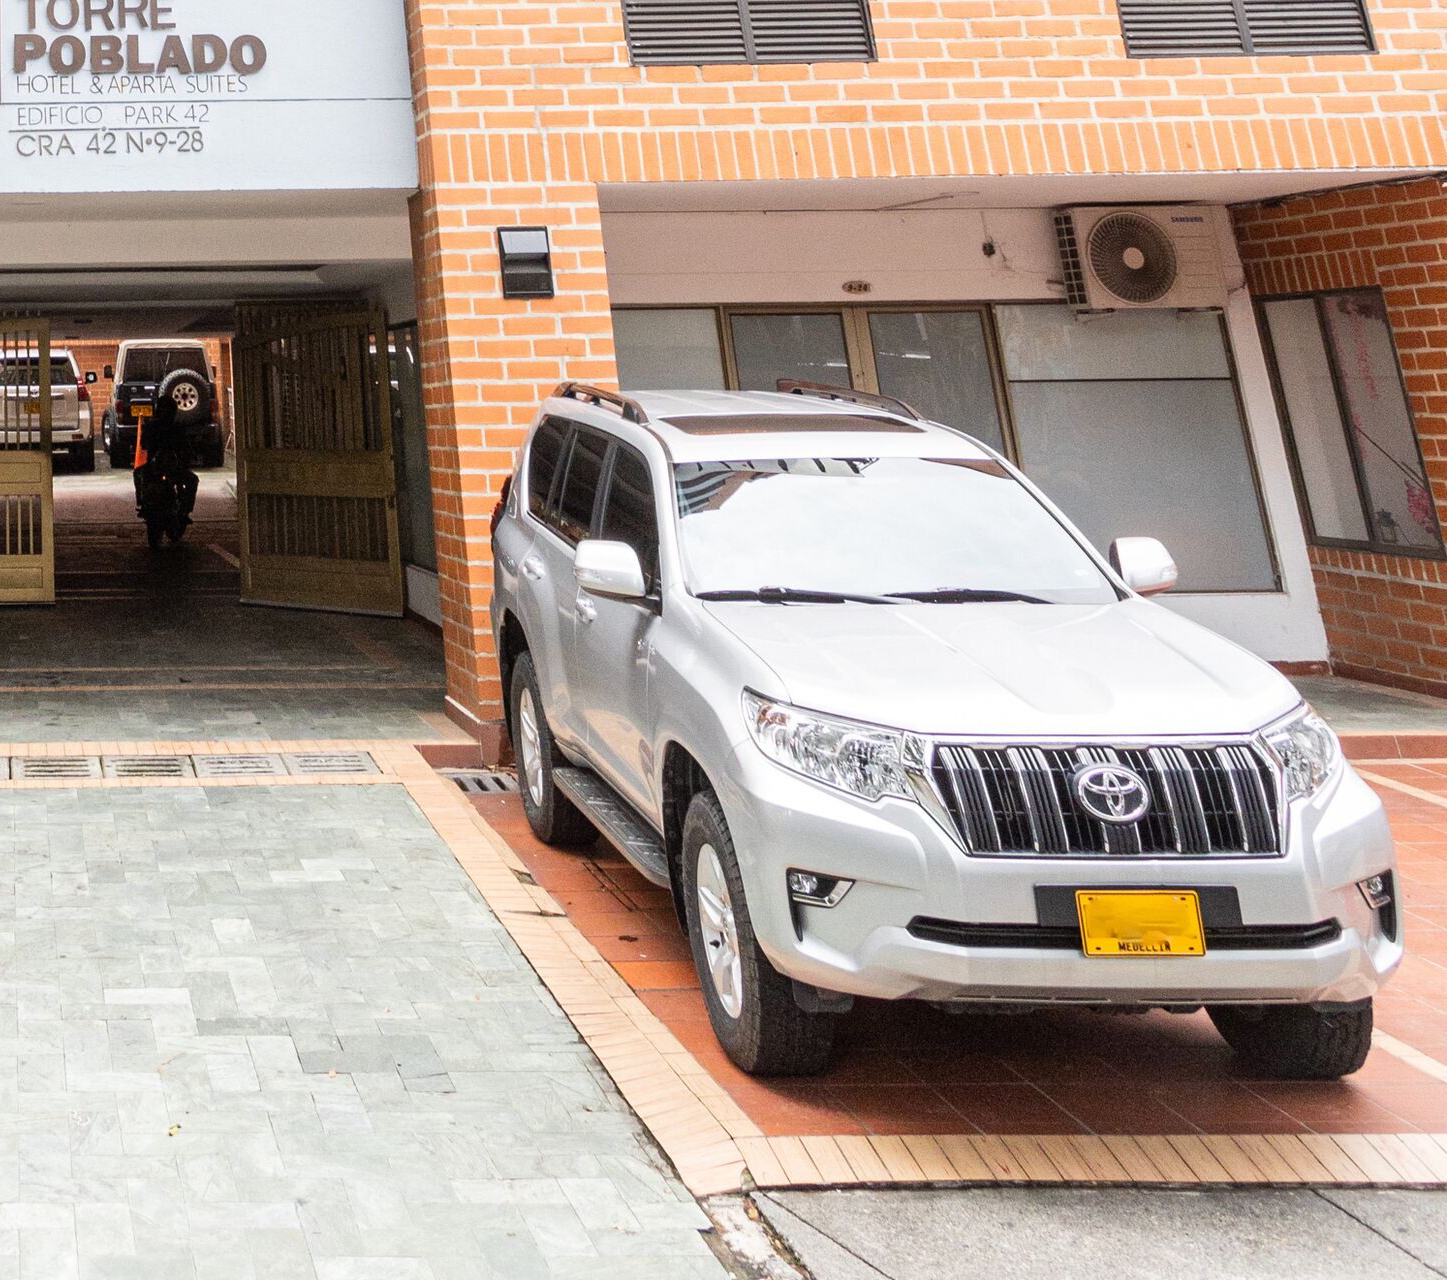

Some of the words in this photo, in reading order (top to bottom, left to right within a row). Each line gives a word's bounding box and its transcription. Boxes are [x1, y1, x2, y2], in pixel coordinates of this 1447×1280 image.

[12, 33, 267, 75] POBLADO
[16, 74, 81, 95] HOTEL
[186, 73, 248, 94] SUITES
[17, 106, 103, 126] EDIFICIO
[124, 104, 178, 125] PARK
[184, 103, 210, 123] 42
[16, 133, 75, 156] CRA
[86, 131, 117, 154] 42
